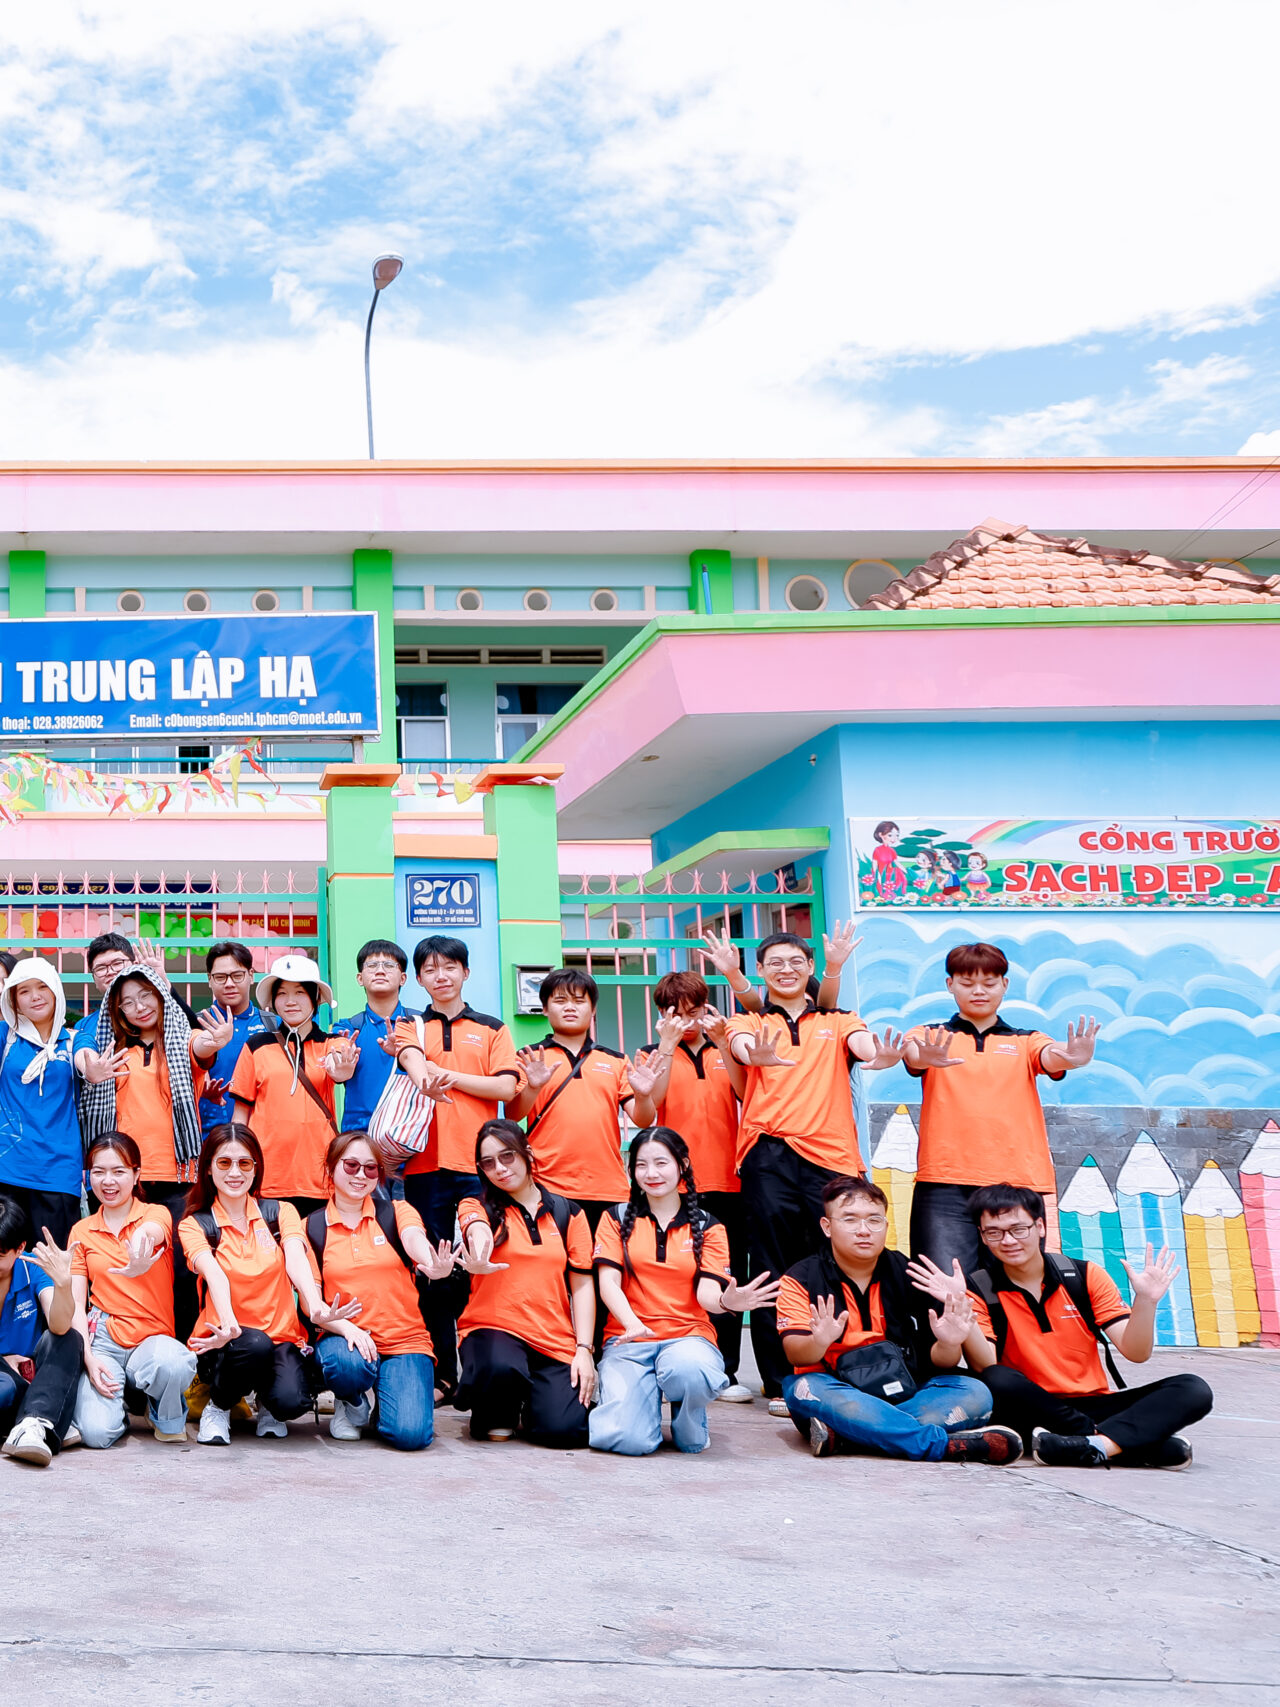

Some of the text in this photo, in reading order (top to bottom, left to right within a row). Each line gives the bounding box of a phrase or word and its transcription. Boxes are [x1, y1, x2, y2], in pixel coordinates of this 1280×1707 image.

[15, 659, 156, 703] TRUNG
[170, 650, 245, 708] LẬP
[258, 655, 318, 706] HẠ
[2, 717, 31, 733] thoại:
[32, 715, 104, 730] 028.38926062
[129, 714, 162, 729] Email:
[1079, 824, 1173, 851] CỔNG
[413, 879, 473, 906] 270
[1004, 864, 1120, 899] SẠCH
[1133, 864, 1222, 899] ĐẸP
